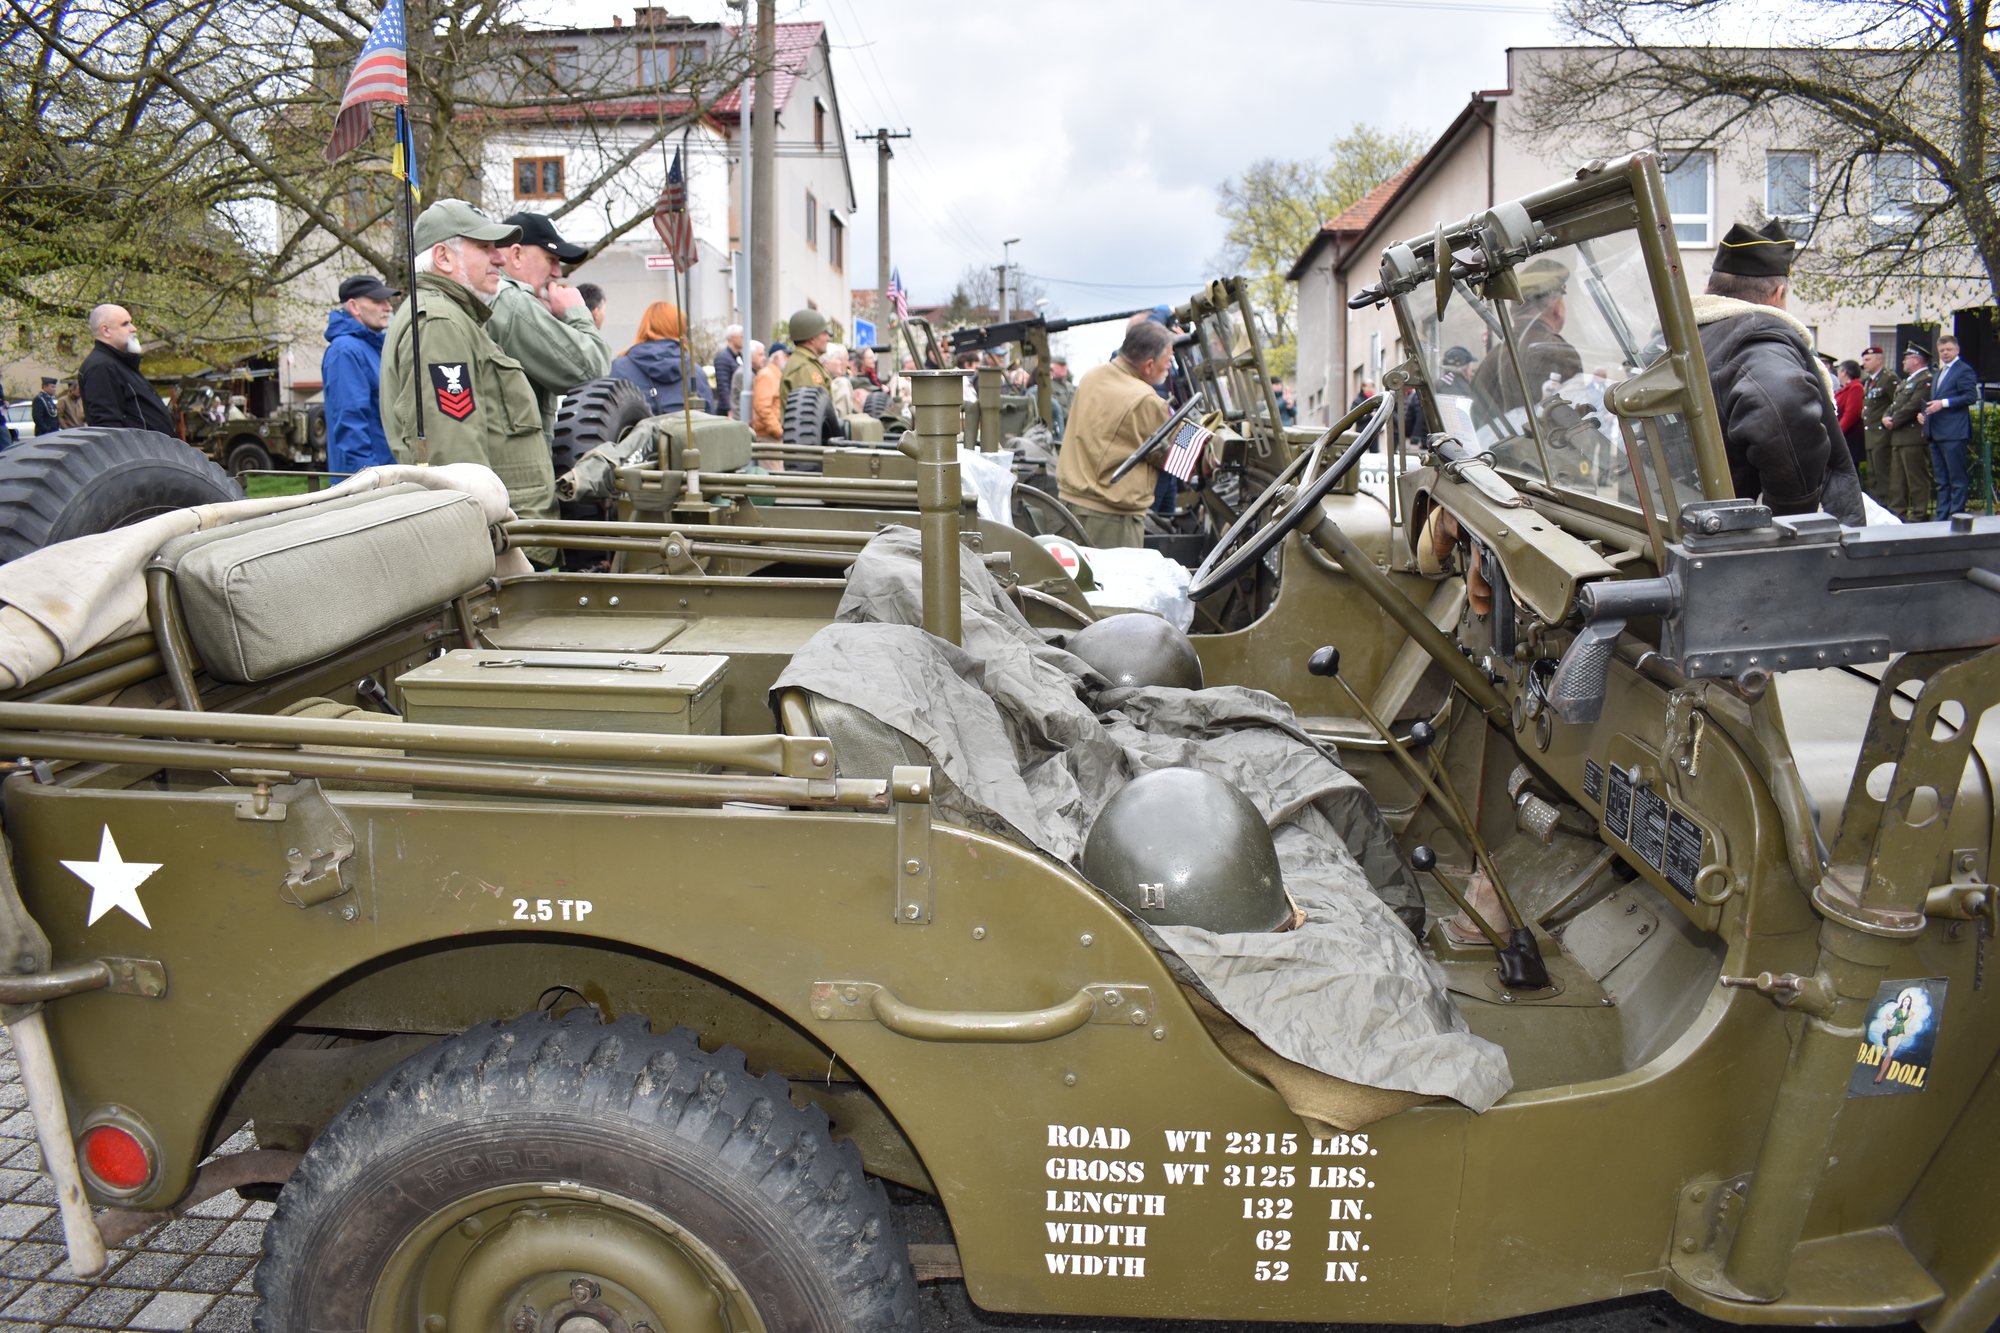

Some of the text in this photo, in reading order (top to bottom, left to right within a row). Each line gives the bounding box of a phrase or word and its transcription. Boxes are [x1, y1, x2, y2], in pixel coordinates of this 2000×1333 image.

[512, 898, 593, 923] 2,5 TP
[1856, 1042, 1927, 1088] DAY DOLL
[1047, 1124, 1378, 1156] ROAD WT 2315 LBS.
[1045, 1157, 1375, 1189] GROSS WT 3125 LBS.
[1046, 1190, 1373, 1220] LENGTH 132 IN.
[1045, 1221, 1370, 1252] WIDTH 62 IN.
[1044, 1253, 1368, 1282] WIDTH 52 IN.
